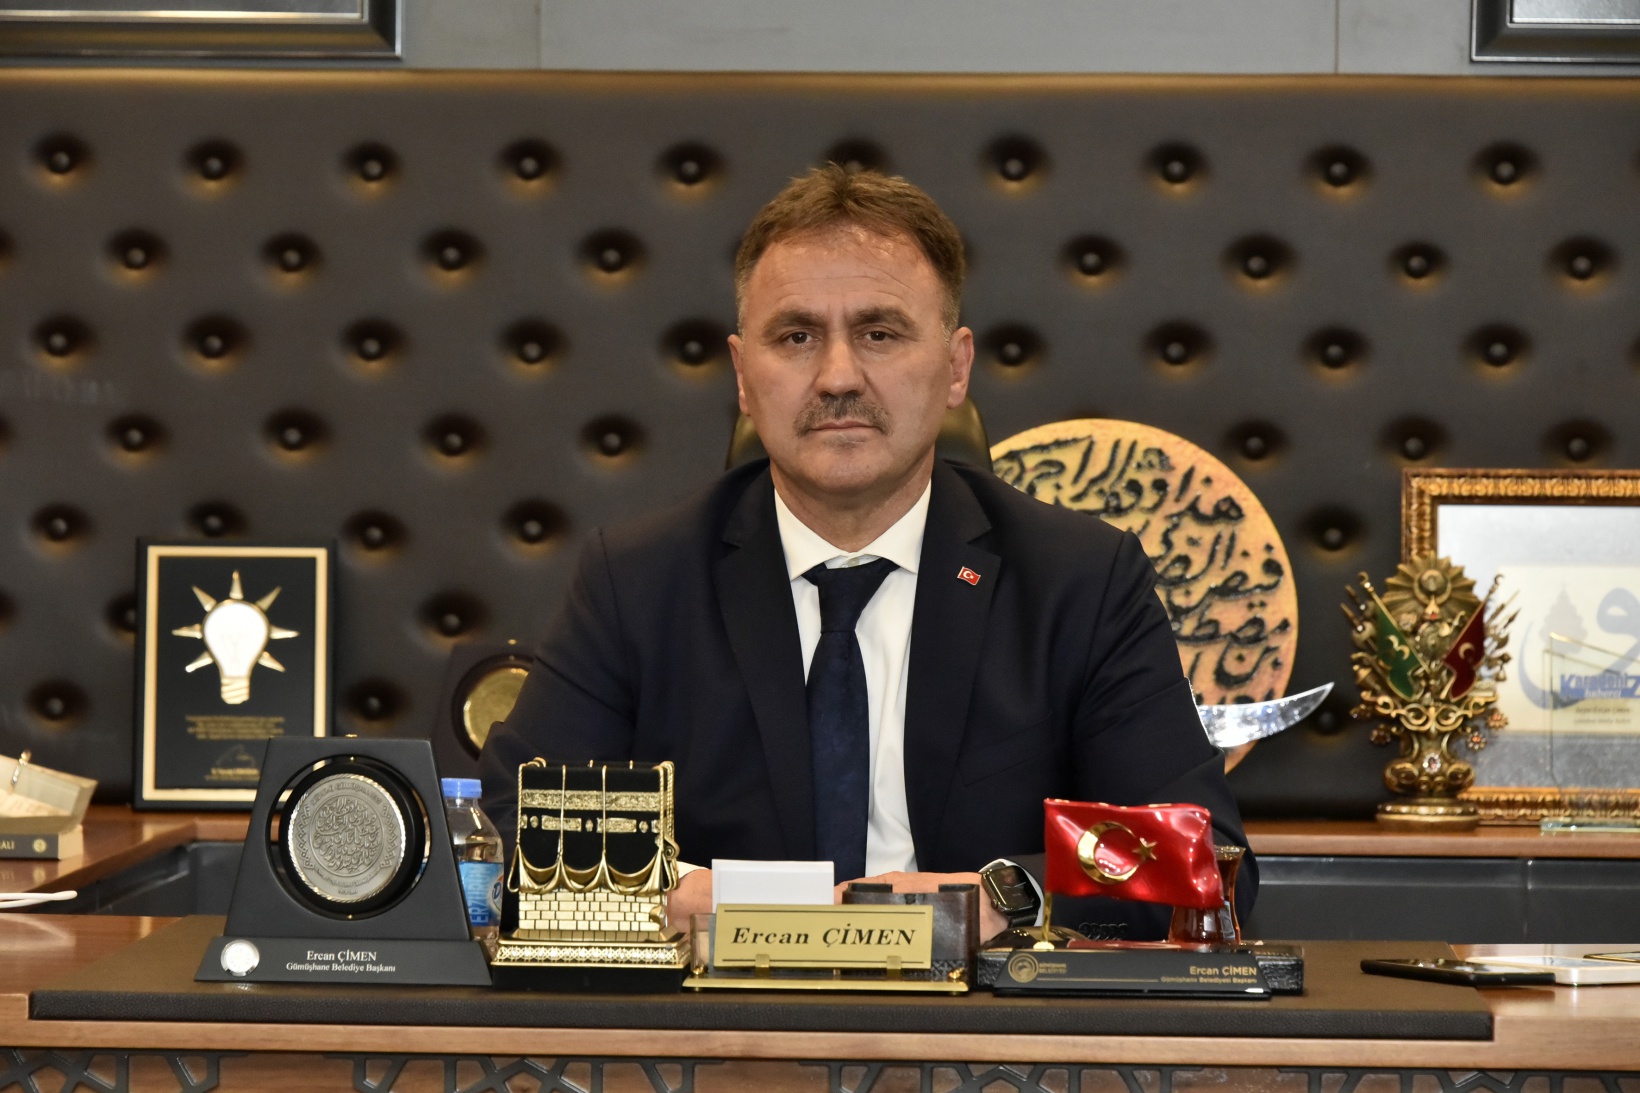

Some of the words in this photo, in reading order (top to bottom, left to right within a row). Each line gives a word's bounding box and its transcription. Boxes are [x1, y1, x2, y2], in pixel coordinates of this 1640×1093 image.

[731, 927, 810, 945] Ercan
[822, 923, 917, 948] ÇİMEN
[306, 950, 335, 961] Ercan
[337, 949, 377, 963] ÇİMEN
[286, 962, 330, 972] Gümüşhane
[331, 963, 365, 973] Belediye
[366, 964, 396, 973] Başkanı
[1189, 965, 1220, 976] Ercan
[1221, 964, 1257, 977] ÇİMEN
